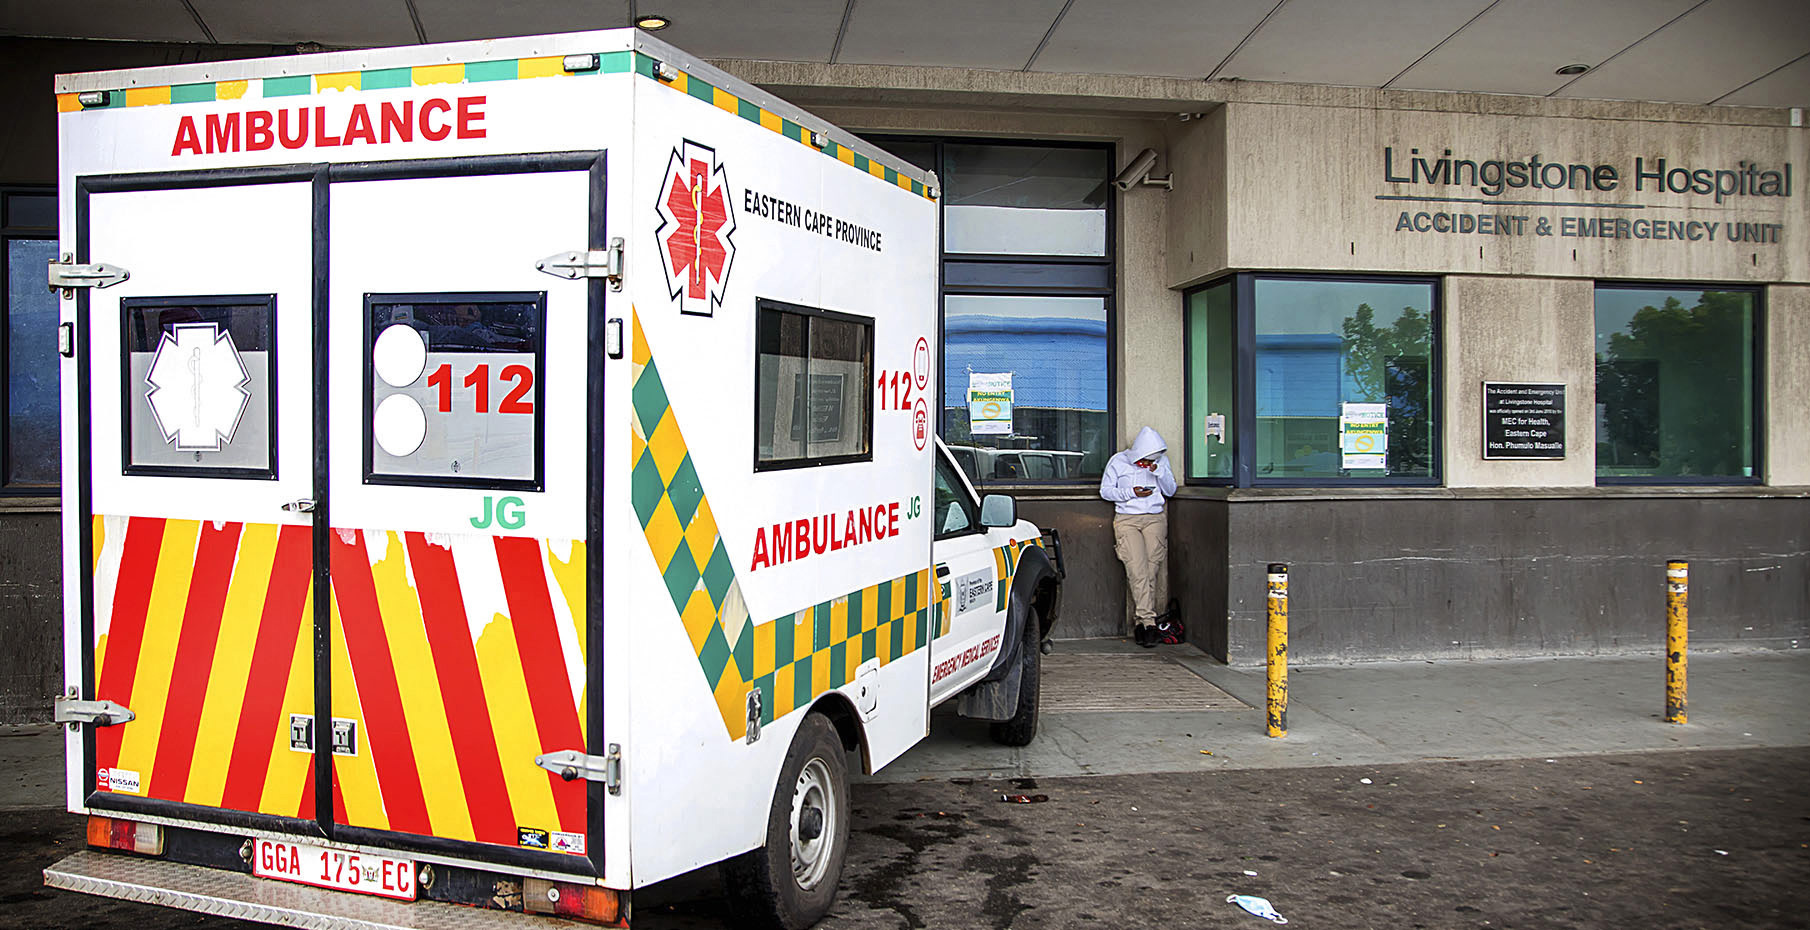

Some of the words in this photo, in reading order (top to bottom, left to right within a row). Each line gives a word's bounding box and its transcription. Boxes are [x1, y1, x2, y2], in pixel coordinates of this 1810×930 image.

[171, 96, 487, 157] AMBULANCE
[1385, 147, 1619, 196] Livingstone
[1635, 157, 1793, 204] Hospital
[744, 188, 801, 228] EASTERN
[804, 209, 832, 237] CAPE
[835, 219, 882, 252] PROVINCE
[1395, 211, 1529, 236] ACCIDENT
[1535, 216, 1553, 236] &
[1561, 217, 1720, 241] EMERGENCY
[1727, 222, 1784, 243] UNIT
[427, 364, 534, 414] 112
[878, 370, 912, 410] 112
[1528, 418, 1551, 426] Health,
[1530, 430, 1547, 438] Cape
[470, 496, 526, 530] JG
[750, 502, 899, 572] AMBULANCE
[907, 495, 921, 520] JG
[969, 585, 984, 598] EASTERN
[984, 580, 993, 592] CAPE
[932, 653, 962, 685] EMERGENCY
[960, 643, 980, 669] MEDICAL
[980, 634, 1000, 658] SERVICES
[110, 778, 139, 787] NISSAN
[262, 841, 301, 876] GGA
[320, 851, 360, 885] 175
[382, 859, 409, 892] EC
